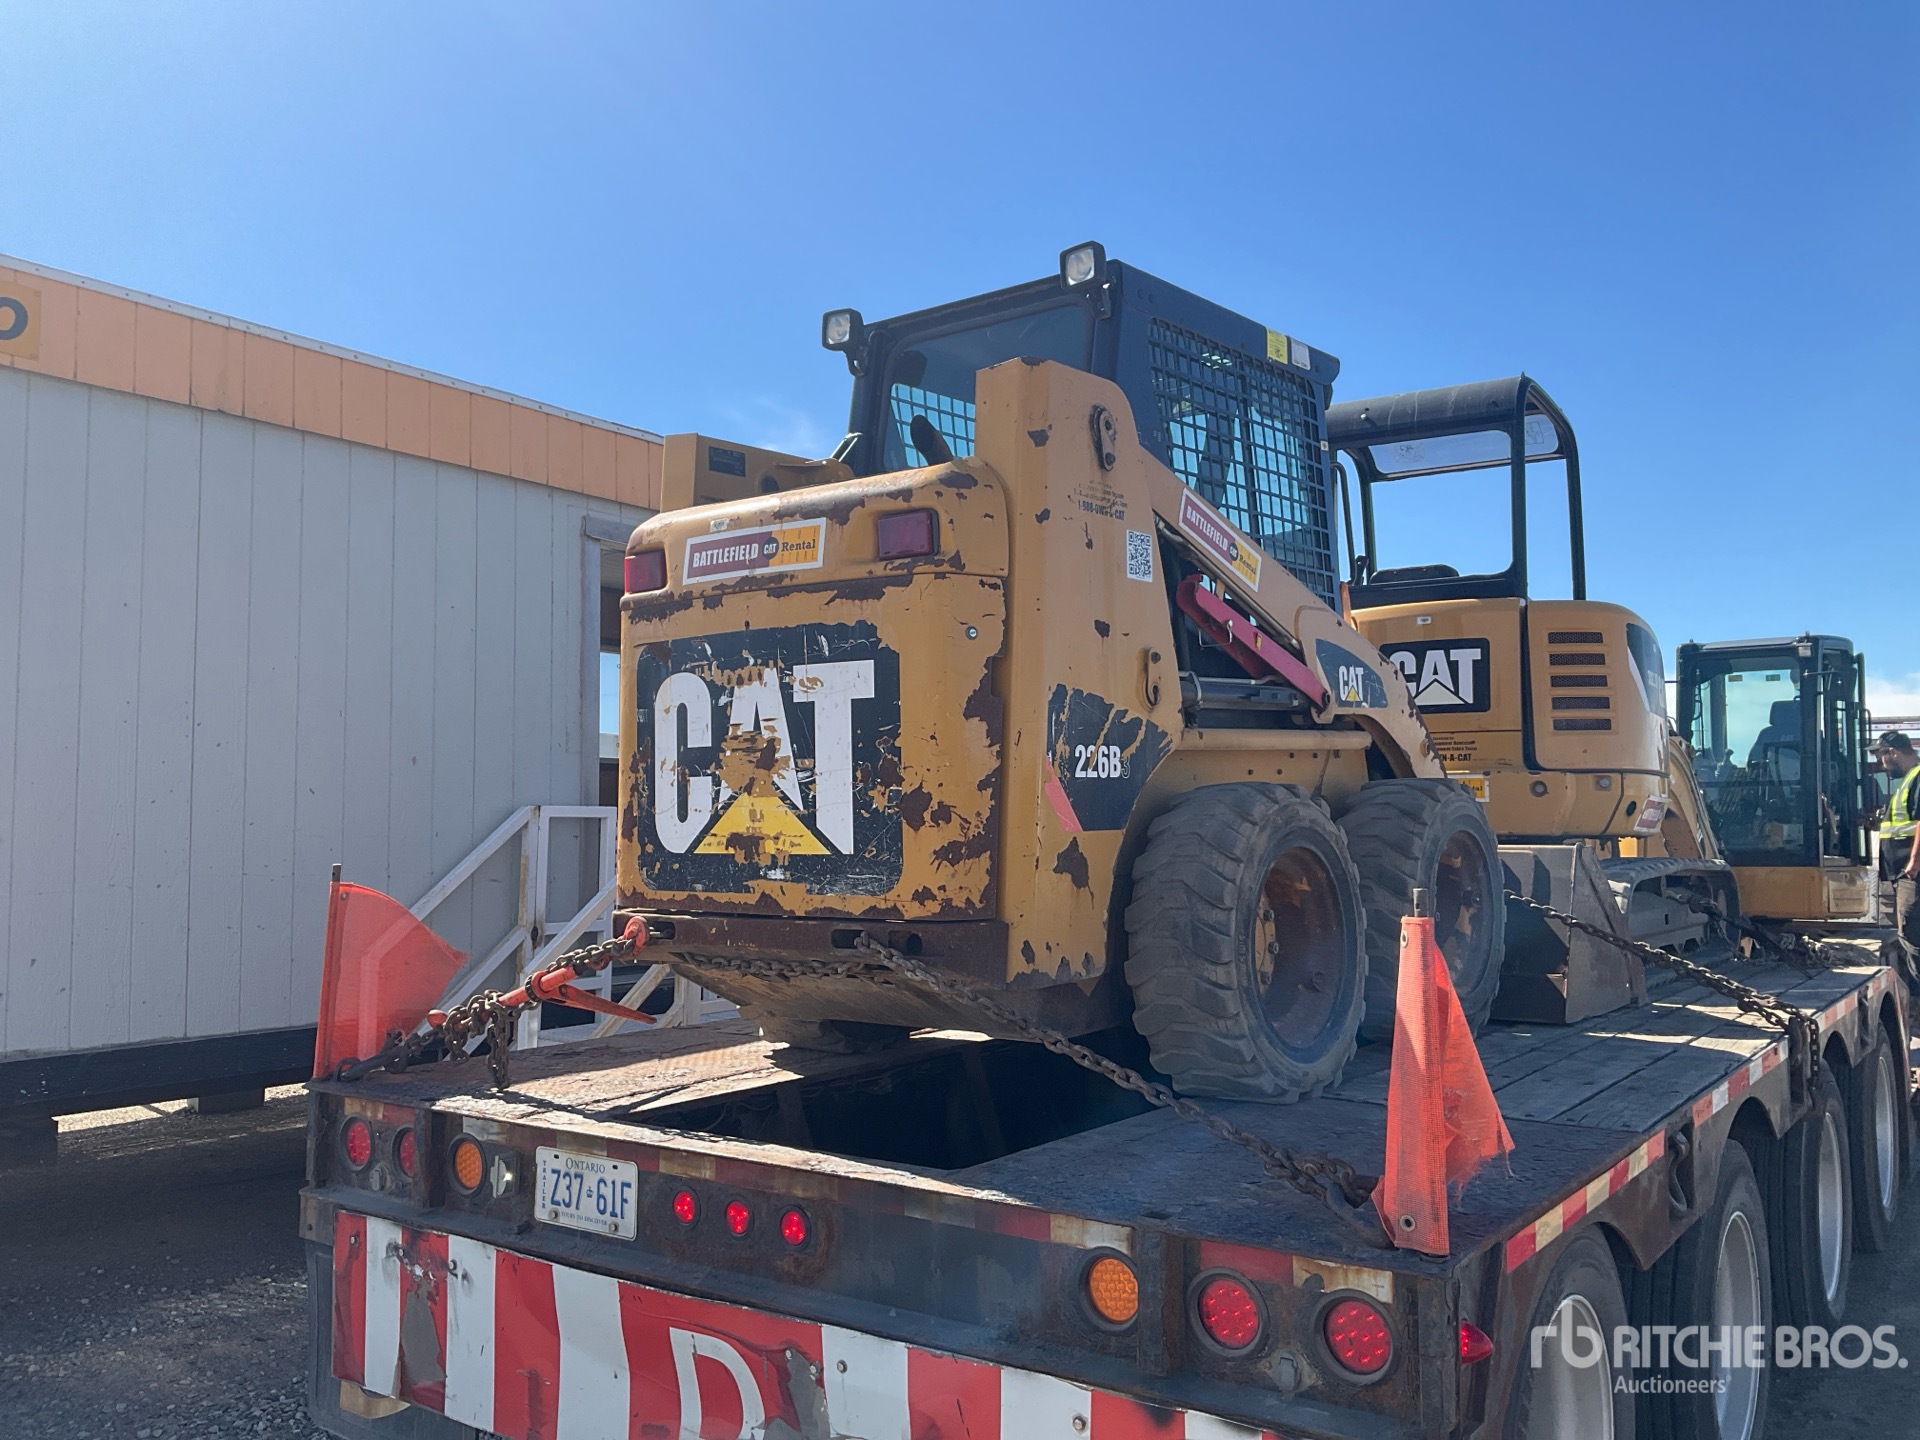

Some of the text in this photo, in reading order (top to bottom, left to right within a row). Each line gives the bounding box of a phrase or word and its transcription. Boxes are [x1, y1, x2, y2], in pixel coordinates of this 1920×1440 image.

[692, 539, 816, 568] BATTLEFIELD CAT Rental
[1186, 505, 1228, 551] BATTLEFIELD
[1229, 546, 1238, 558] CAT
[1338, 665, 1365, 702] CAT
[1389, 648, 1482, 704] CAT
[654, 660, 875, 855] CAT
[565, 1157, 606, 1175] ONTARIO
[550, 1168, 632, 1219] Z37 61F
[560, 1211, 576, 1220] YOURS
[584, 1216, 608, 1226] DISCOVER
